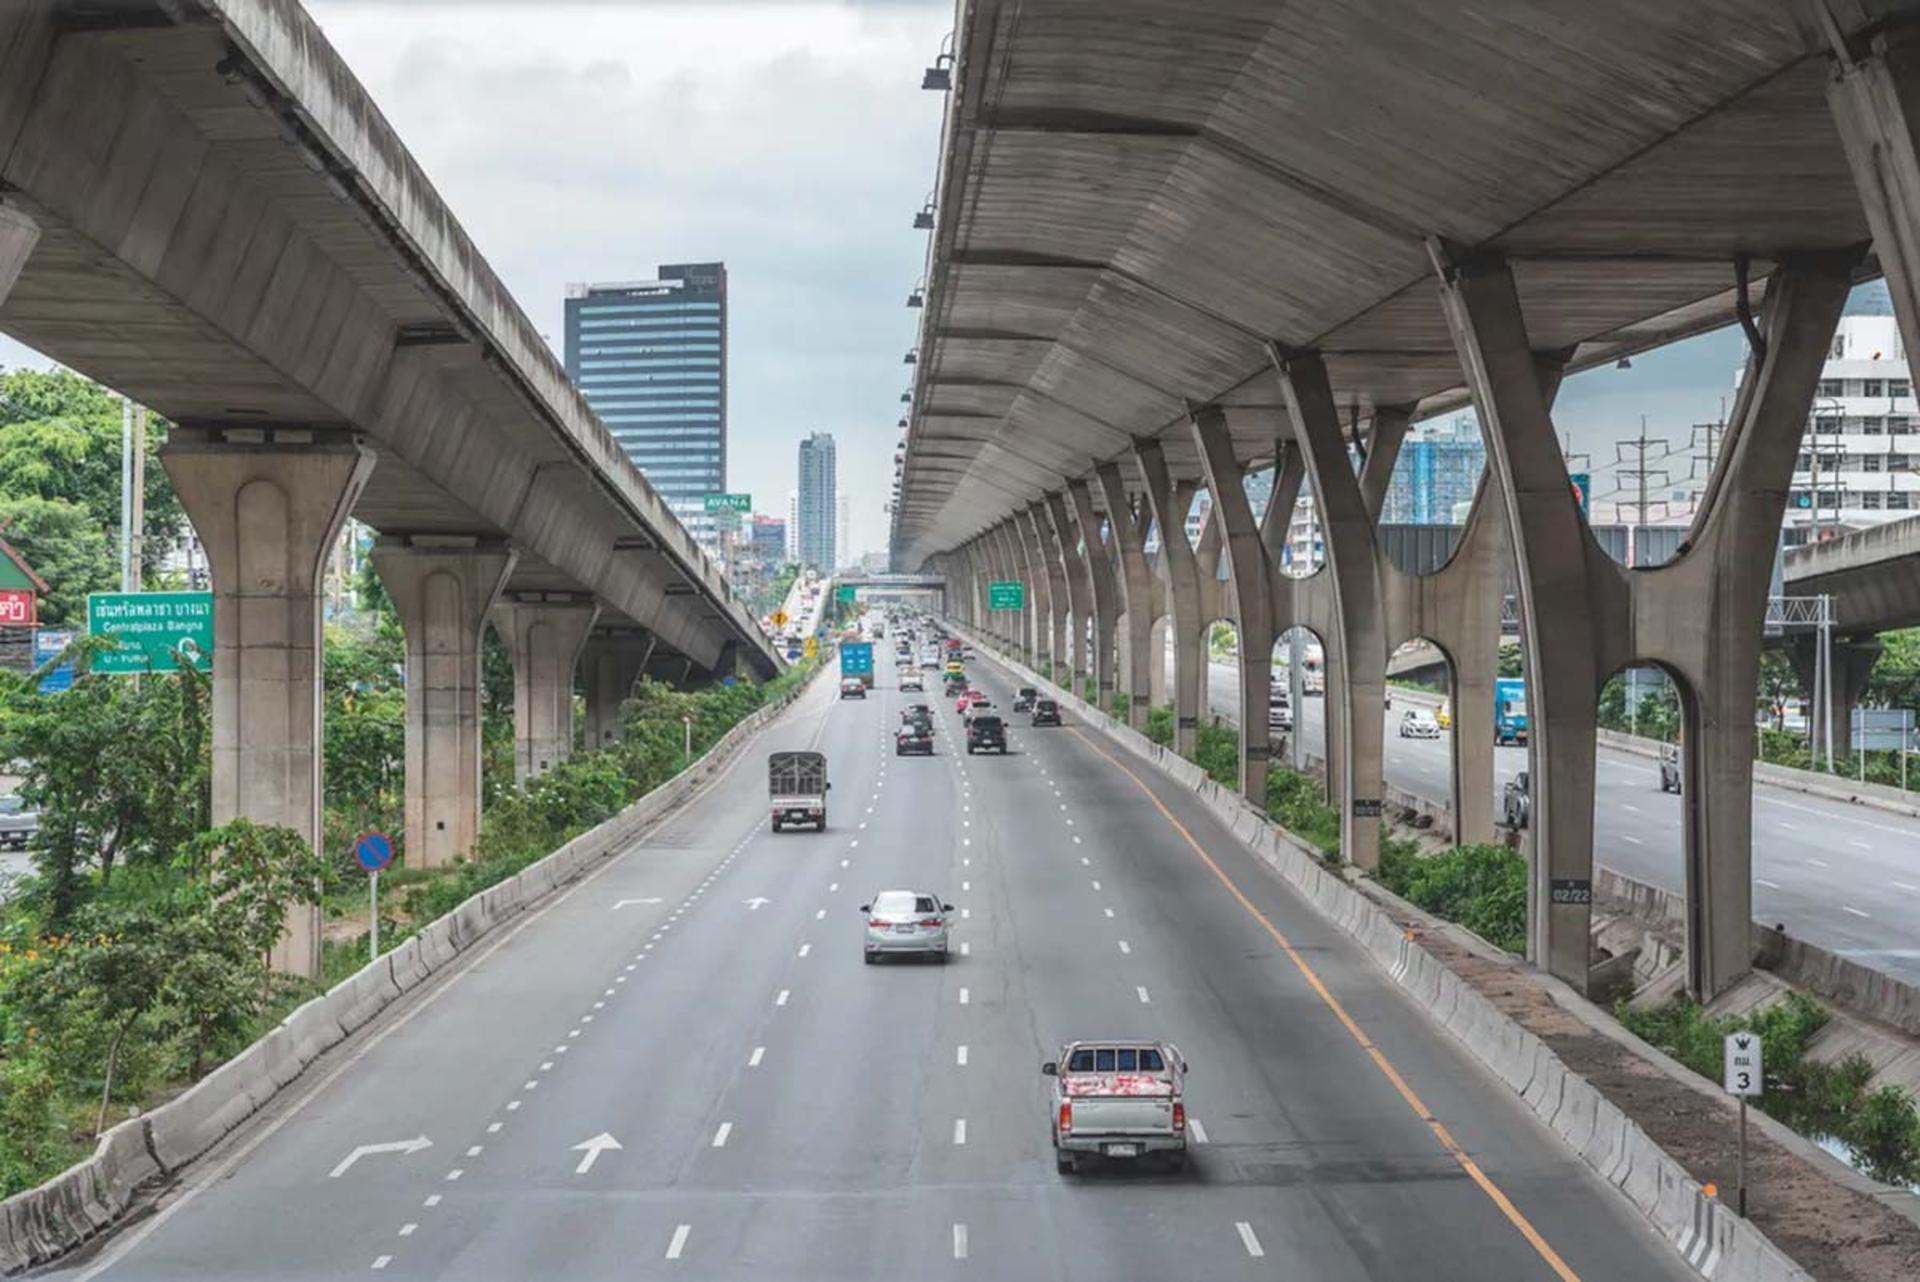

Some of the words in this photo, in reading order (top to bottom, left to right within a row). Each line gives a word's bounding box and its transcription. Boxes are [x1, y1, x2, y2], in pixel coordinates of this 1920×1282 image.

[707, 498, 748, 508] AVANA
[175, 602, 209, 616] บางนา
[1737, 1072, 1750, 1089] 3
